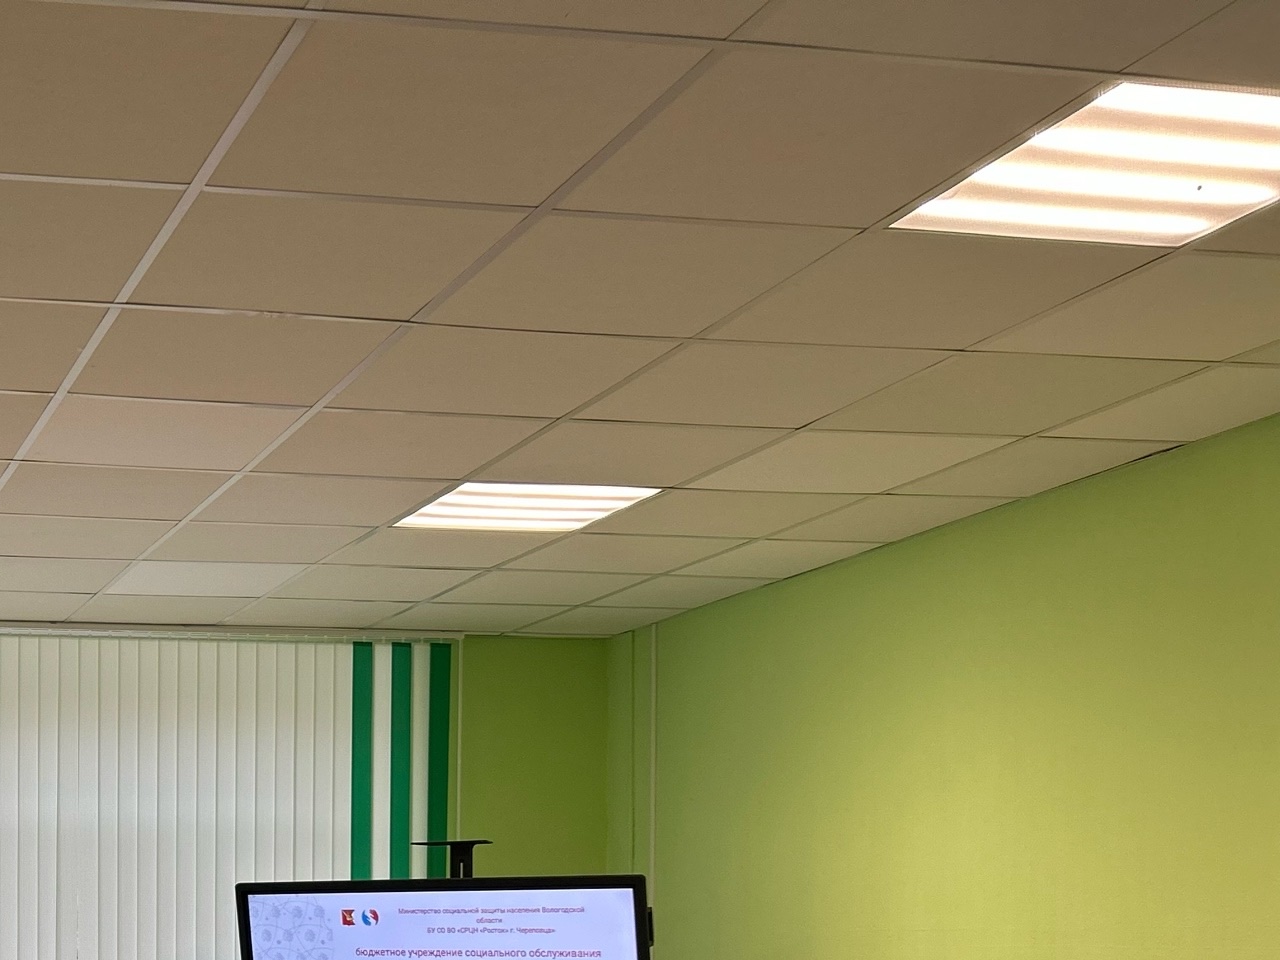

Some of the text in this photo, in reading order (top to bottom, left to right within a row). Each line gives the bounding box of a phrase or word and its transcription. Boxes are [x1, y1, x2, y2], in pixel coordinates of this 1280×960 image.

[356, 948, 602, 959] бюджетное учреждение социального обслуживания
